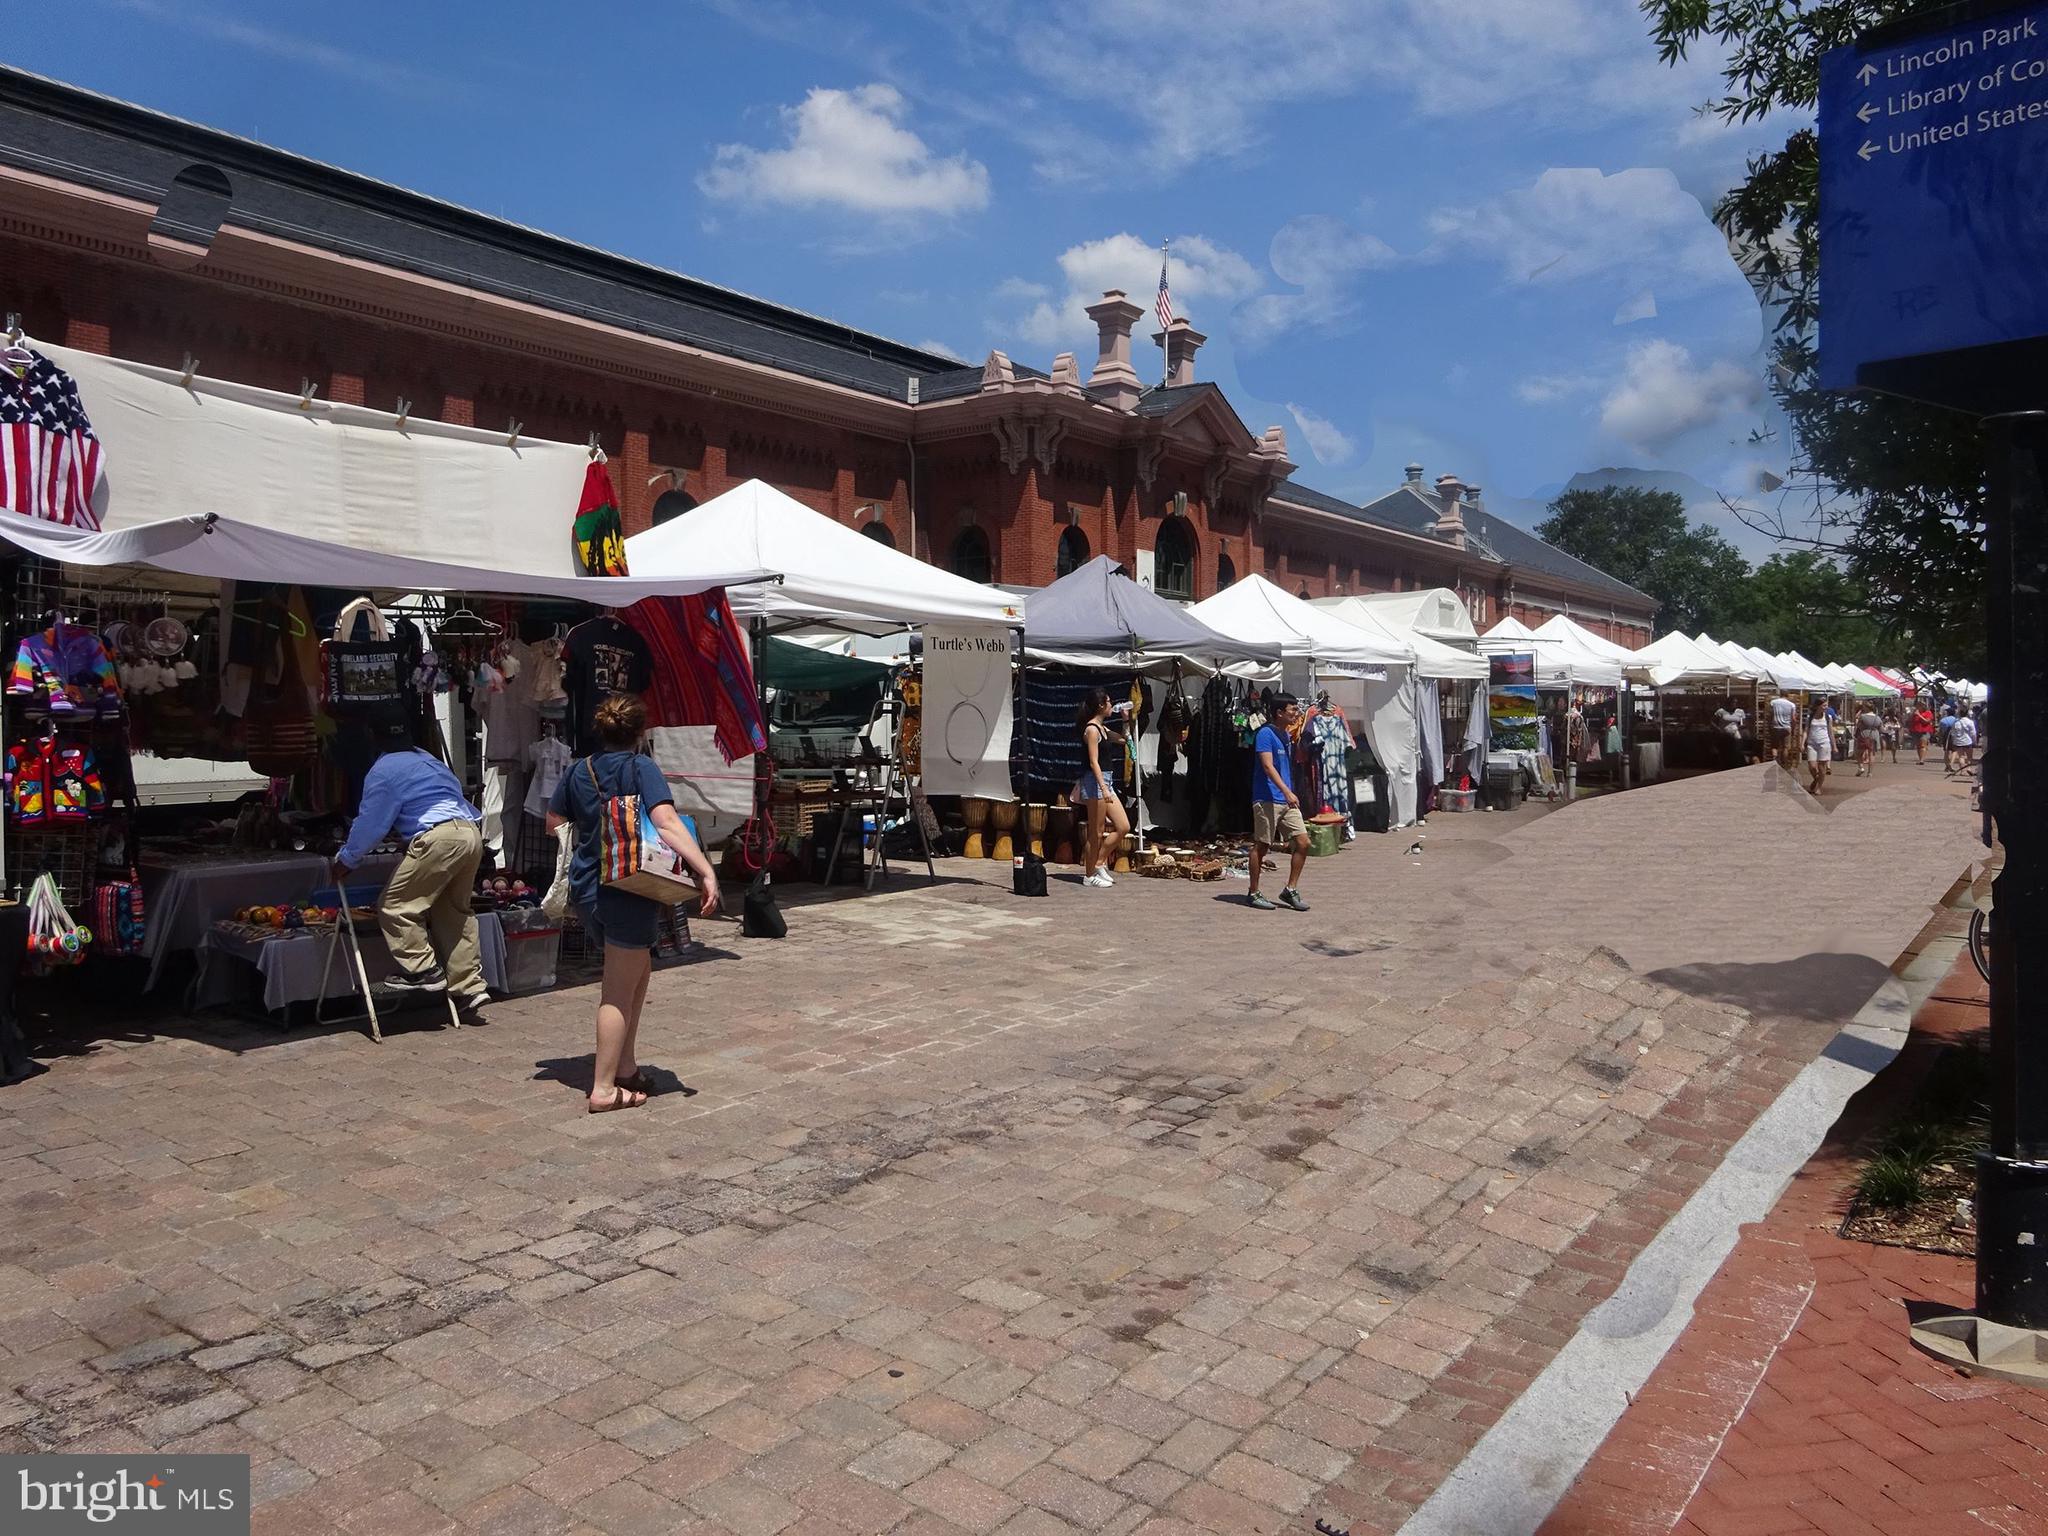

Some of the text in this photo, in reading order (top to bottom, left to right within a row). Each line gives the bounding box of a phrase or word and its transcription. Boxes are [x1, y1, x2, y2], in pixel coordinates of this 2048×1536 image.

[1887, 18, 2038, 78] Lincoln Park
[1888, 60, 2048, 116] Library of Co
[1888, 115, 1968, 154] United
[931, 636, 1005, 653] Turtle's Webb
